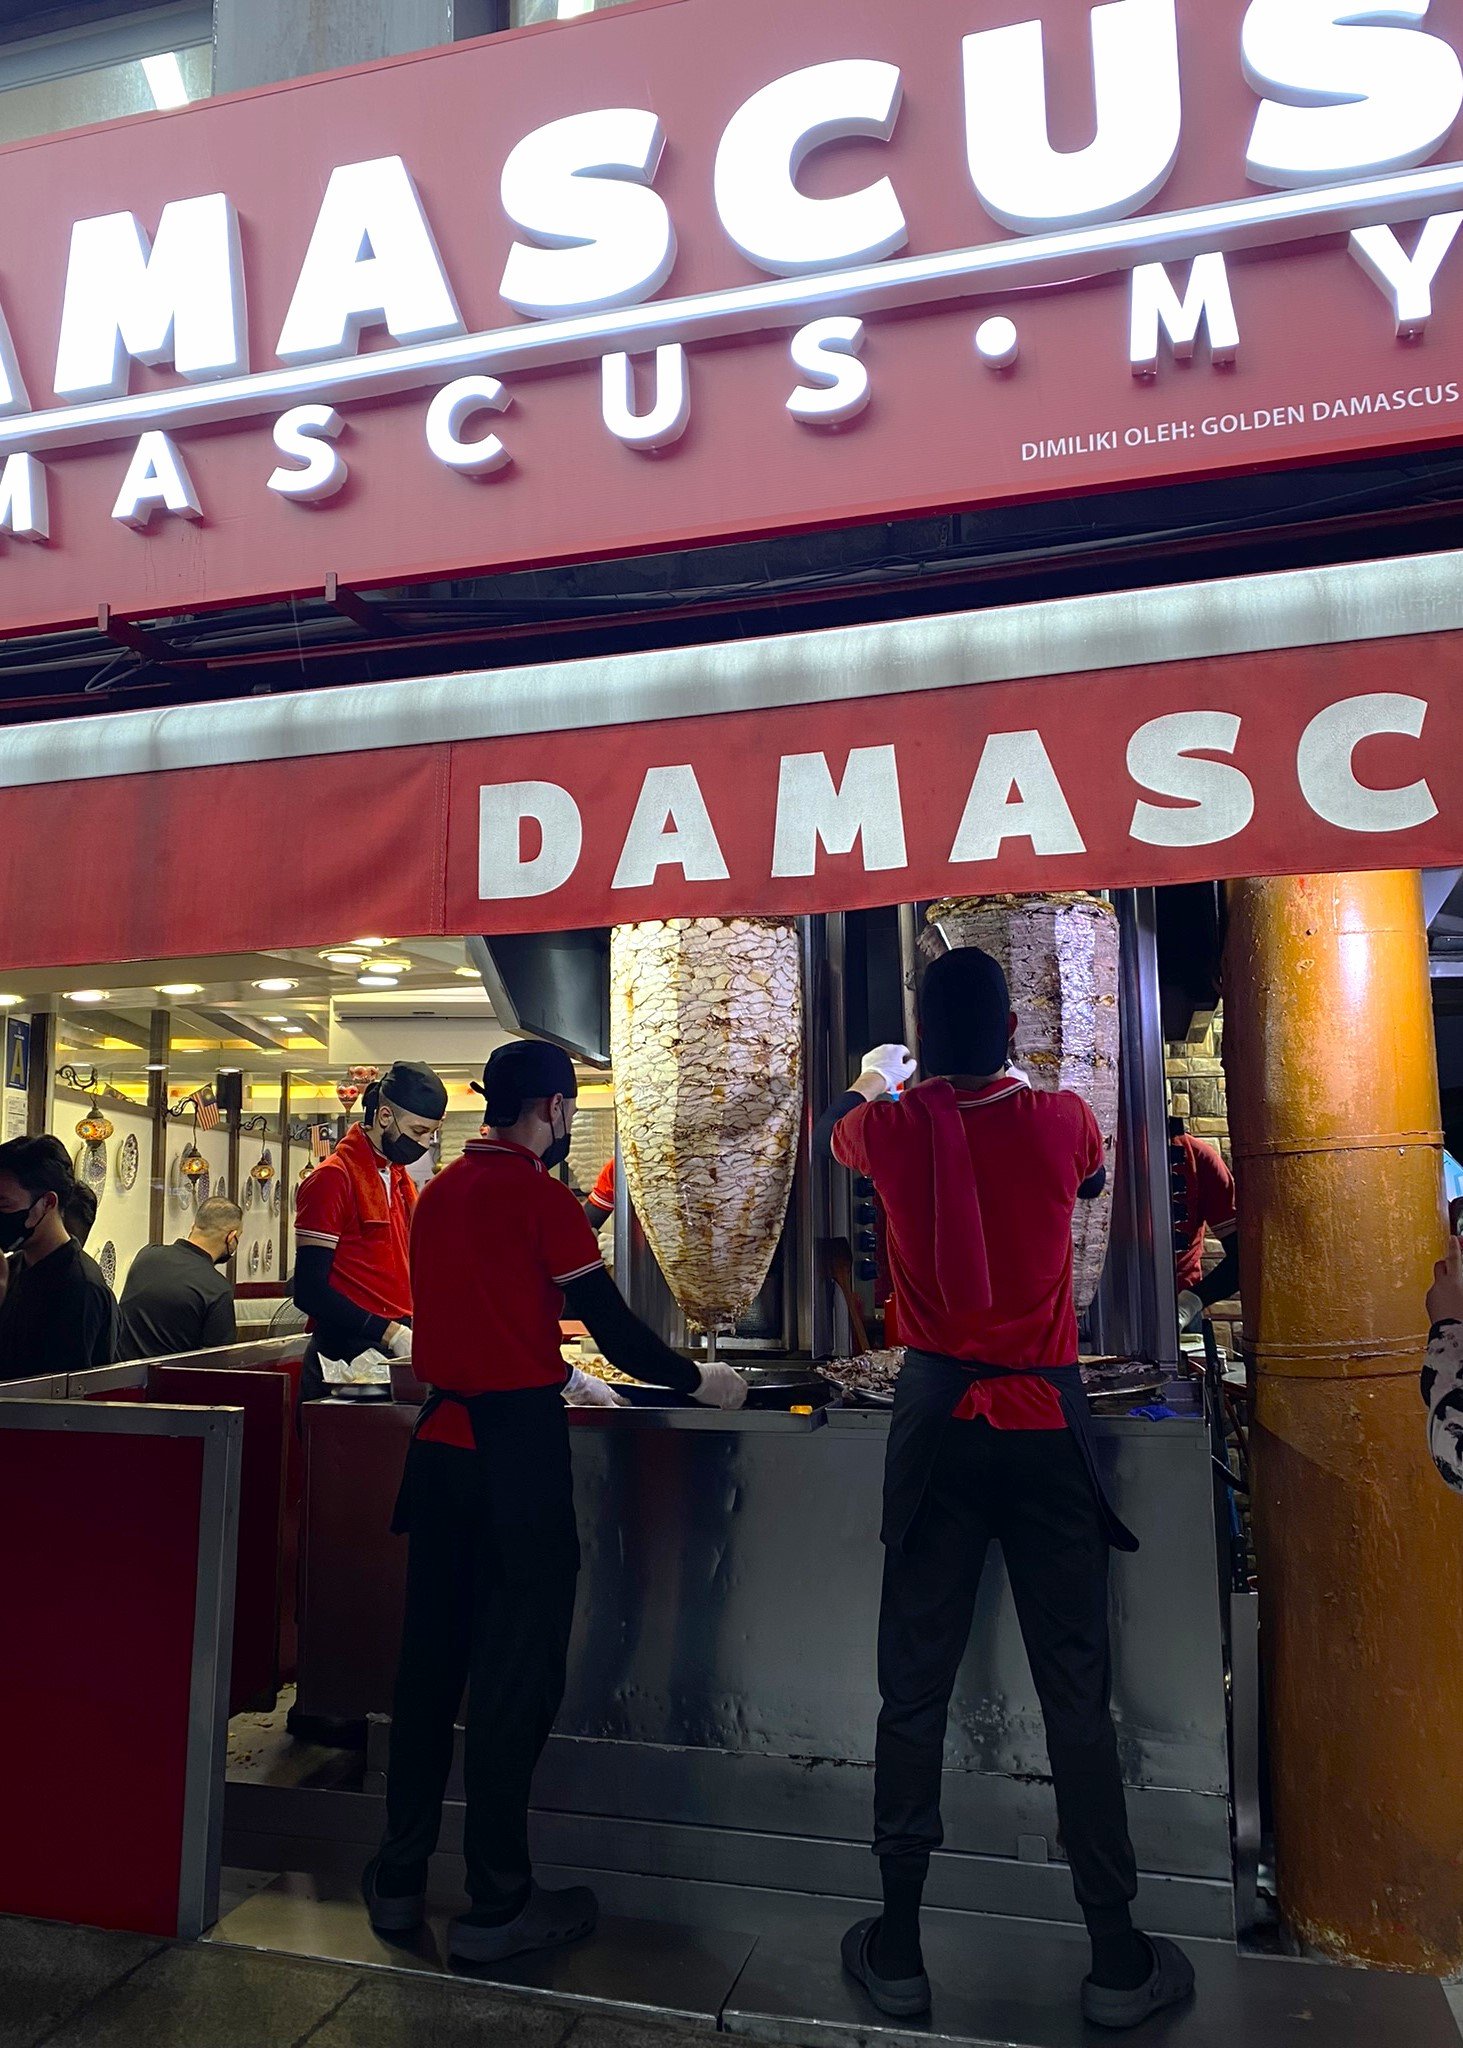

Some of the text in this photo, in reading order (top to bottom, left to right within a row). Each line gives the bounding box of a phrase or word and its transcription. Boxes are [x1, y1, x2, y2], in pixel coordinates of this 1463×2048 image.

[0, 0, 1463, 406] MASCUS
[1021, 382, 1460, 462] DIMILIKI OLEH: GOLDEN DAMASCUS
[478, 692, 1440, 901] DAMASC
